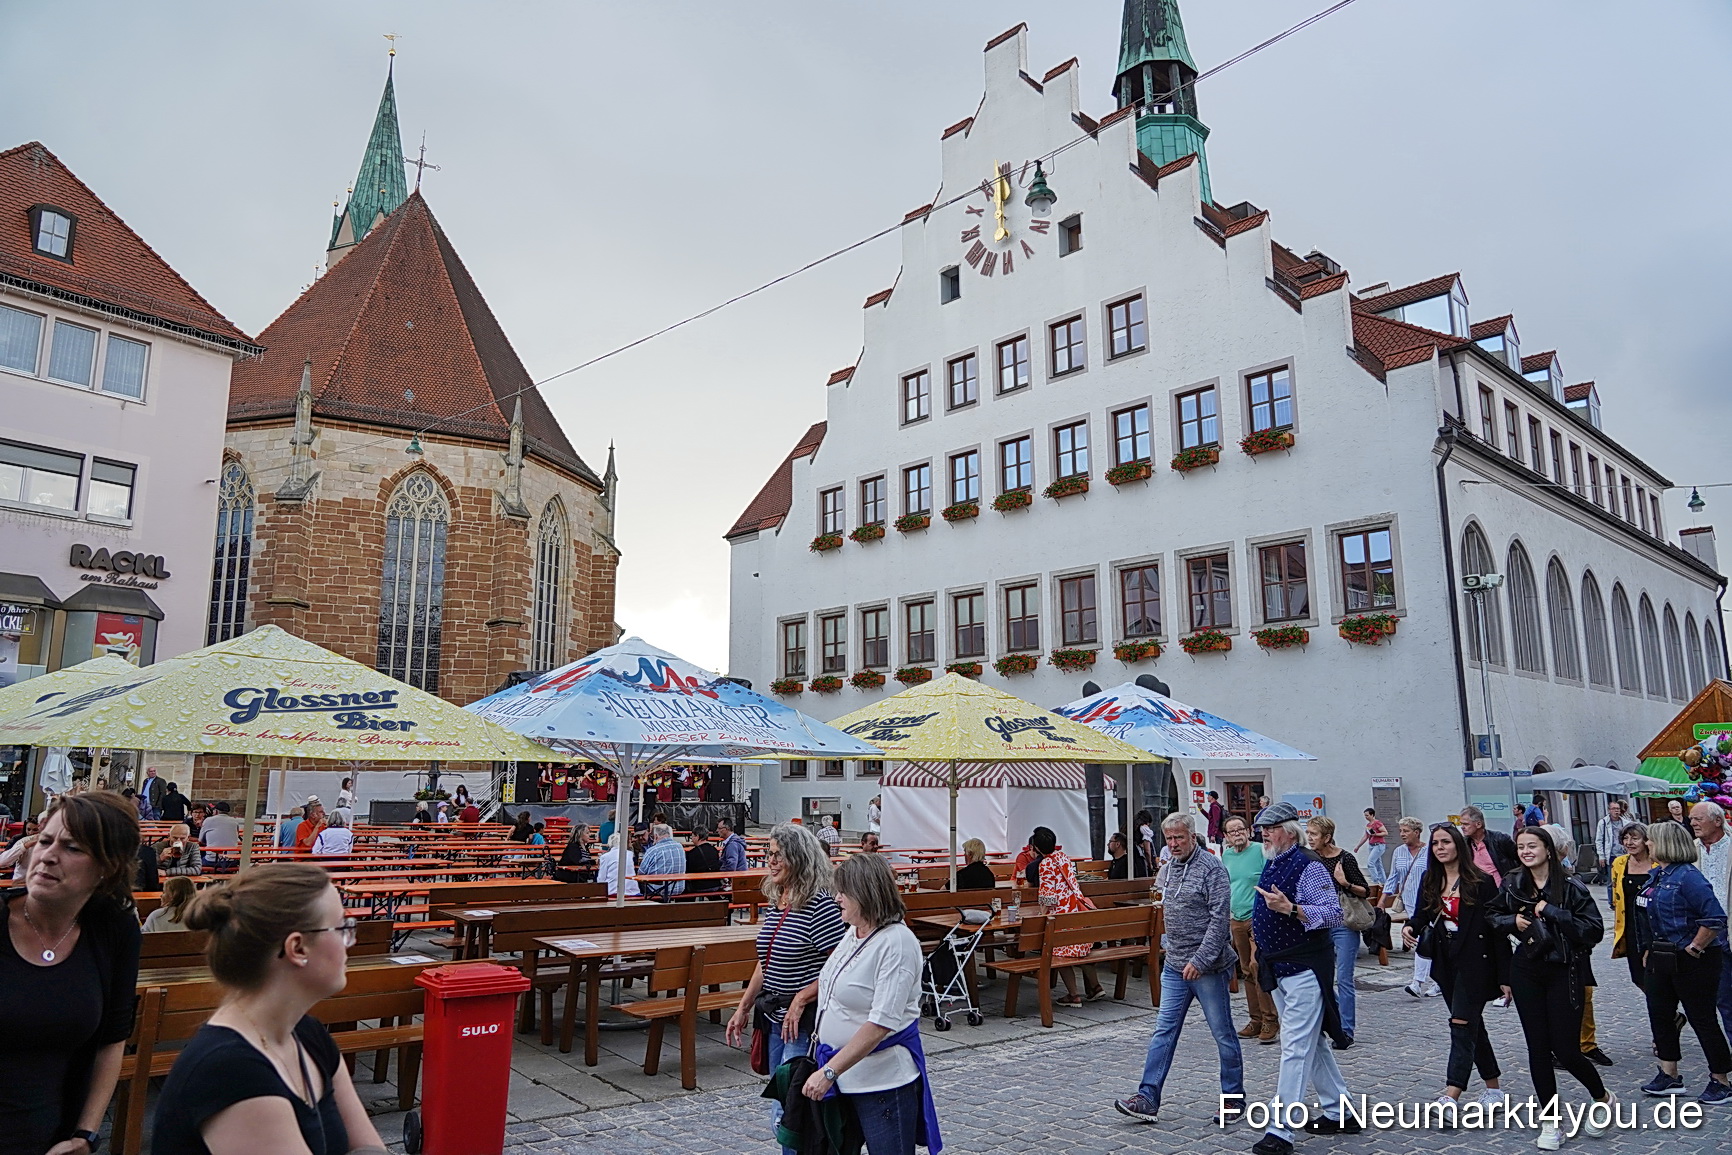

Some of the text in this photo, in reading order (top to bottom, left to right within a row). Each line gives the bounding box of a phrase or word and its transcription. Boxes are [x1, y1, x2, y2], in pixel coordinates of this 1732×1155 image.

[70, 543, 171, 579] RACKL
[80, 572, 158, 590] am Rathaus
[0, 614, 24, 630] CKL!
[223, 687, 400, 725] Glossner
[599, 690, 787, 730] NEUMARKTER
[332, 712, 418, 732] Bier
[640, 719, 778, 739] MINERALBRUNNEN
[201, 724, 462, 748] Der hochfeine Biergenuss
[641, 733, 795, 748] WASSER ZUM LEBEN
[462, 1025, 498, 1036] SULO
